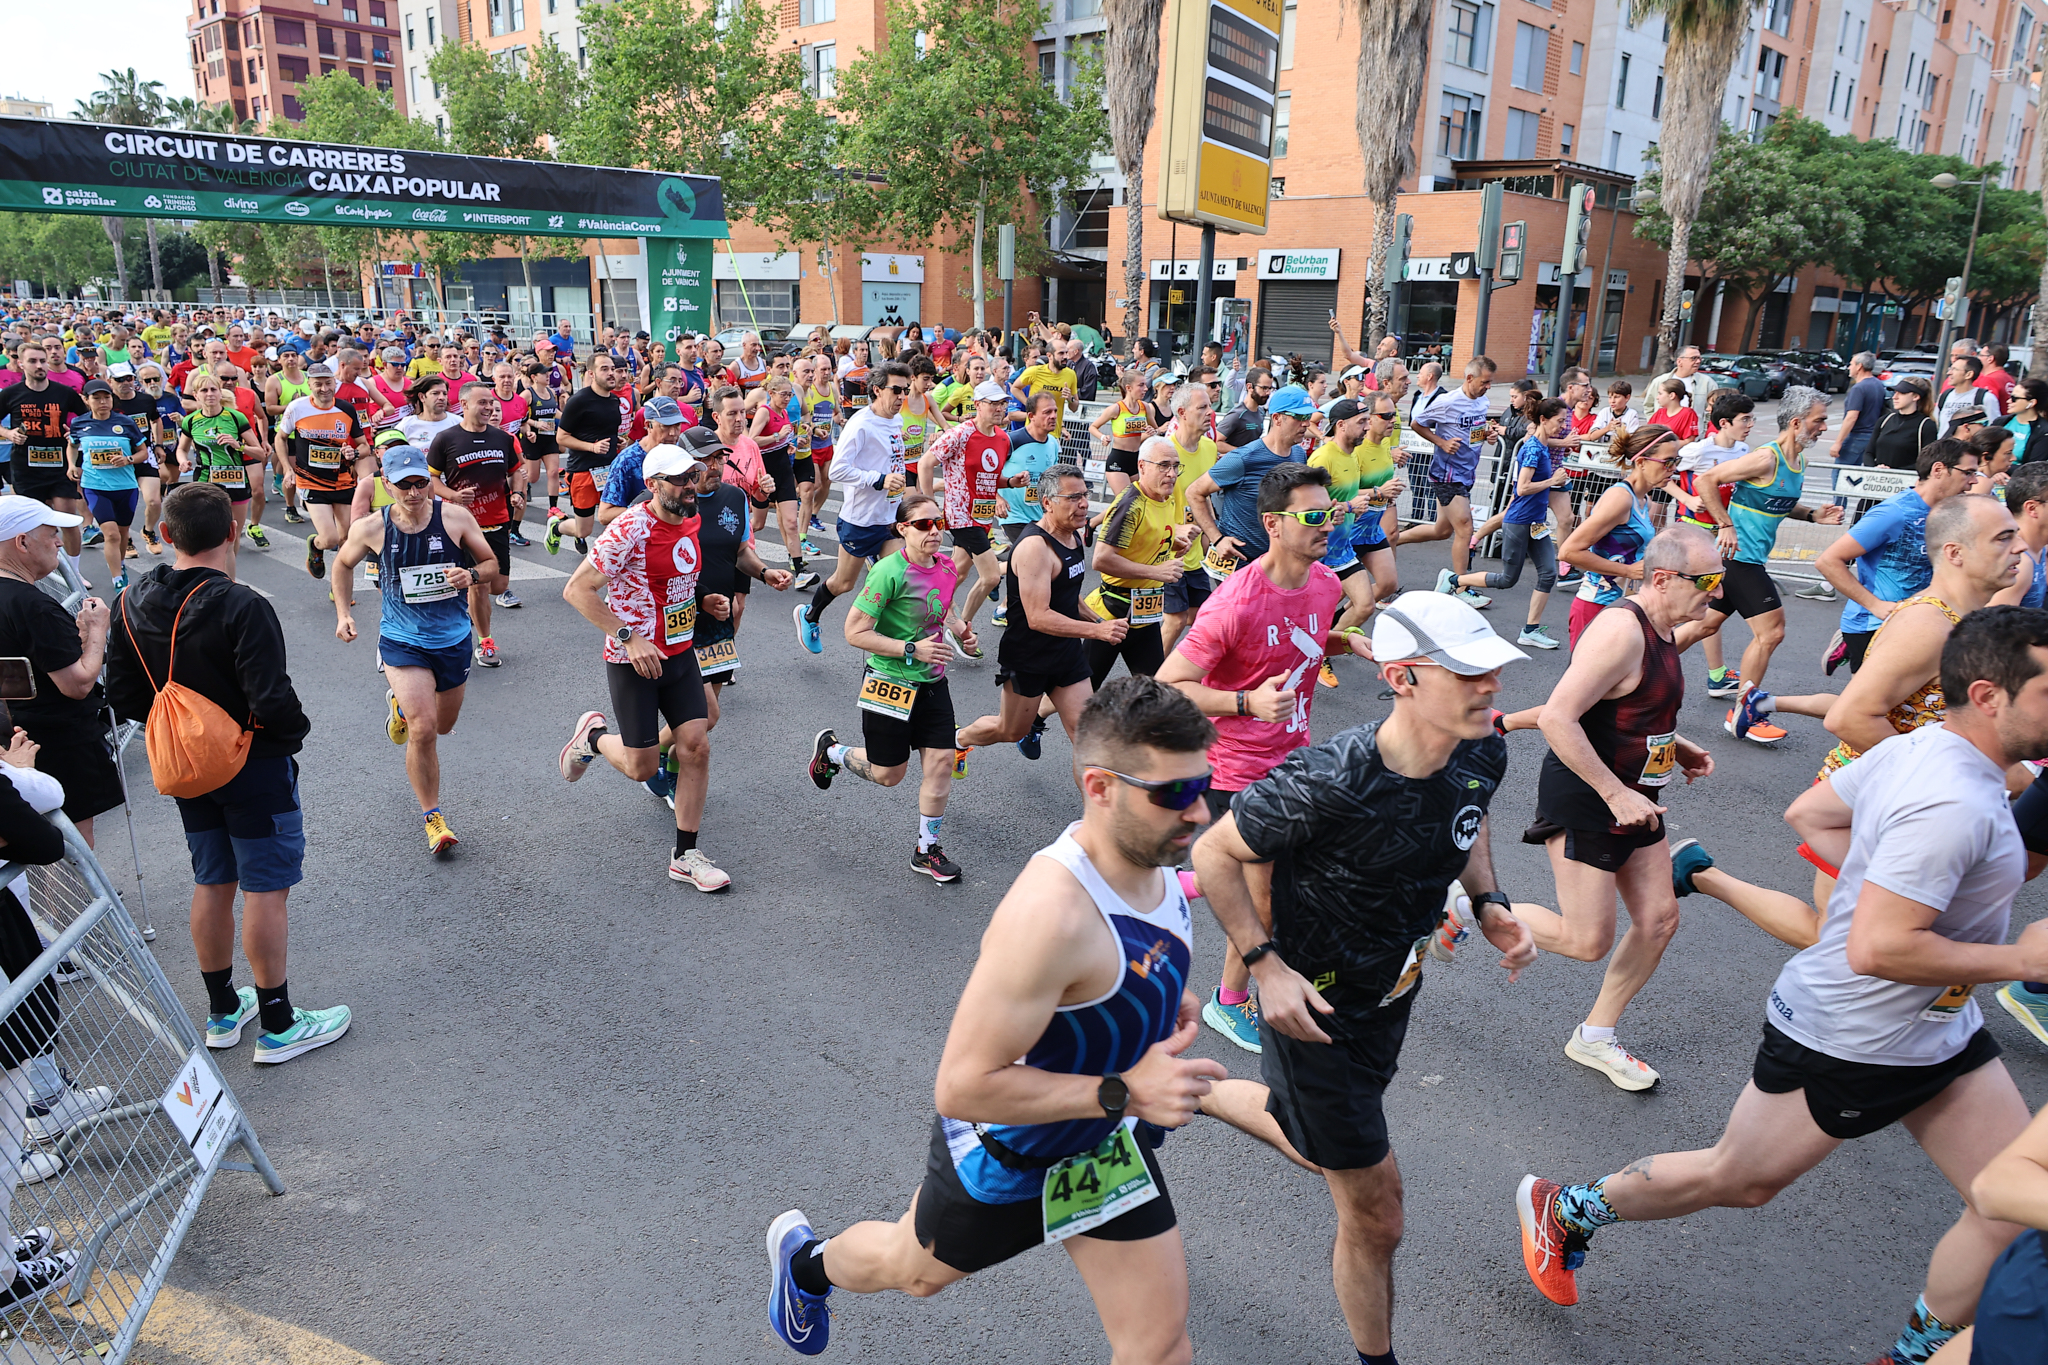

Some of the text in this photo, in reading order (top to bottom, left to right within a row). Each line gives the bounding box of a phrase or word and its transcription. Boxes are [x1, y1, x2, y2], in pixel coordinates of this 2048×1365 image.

[104, 132, 406, 174] CIRCUIT DE CARRERES
[109, 160, 305, 188] CIUTAT DE VALÈNCIA
[64, 189, 98, 198] caixa
[65, 197, 117, 206] popular
[224, 197, 258, 210] divina
[1200, 190, 1265, 216] AJUNTAMENT DE VALENCIA
[164, 204, 197, 212] ALFONSO
[344, 206, 365, 217] Corte
[472, 214, 531, 226] INTERSPORT
[578, 218, 662, 232] #ValènciaCorre
[1286, 256, 1328, 266] BeUrban
[1284, 265, 1326, 276] Running
[1108, 290, 1118, 300] 37
[31, 451, 60, 459] 3861
[311, 450, 339, 460] 3847
[212, 471, 242, 479] 3860
[595, 473, 608, 483] 35
[1865, 475, 1904, 485] VALENCIA
[1862, 484, 1892, 494] CIUDAD
[974, 505, 996, 514] 3554
[1207, 550, 1235, 570] 4082
[412, 572, 445, 587] 725
[1135, 595, 1163, 611] 3974
[1267, 613, 1318, 647] R U
[698, 643, 734, 662] 3440
[865, 679, 912, 704] 3661
[1216, 1006, 1237, 1030] HOKA
